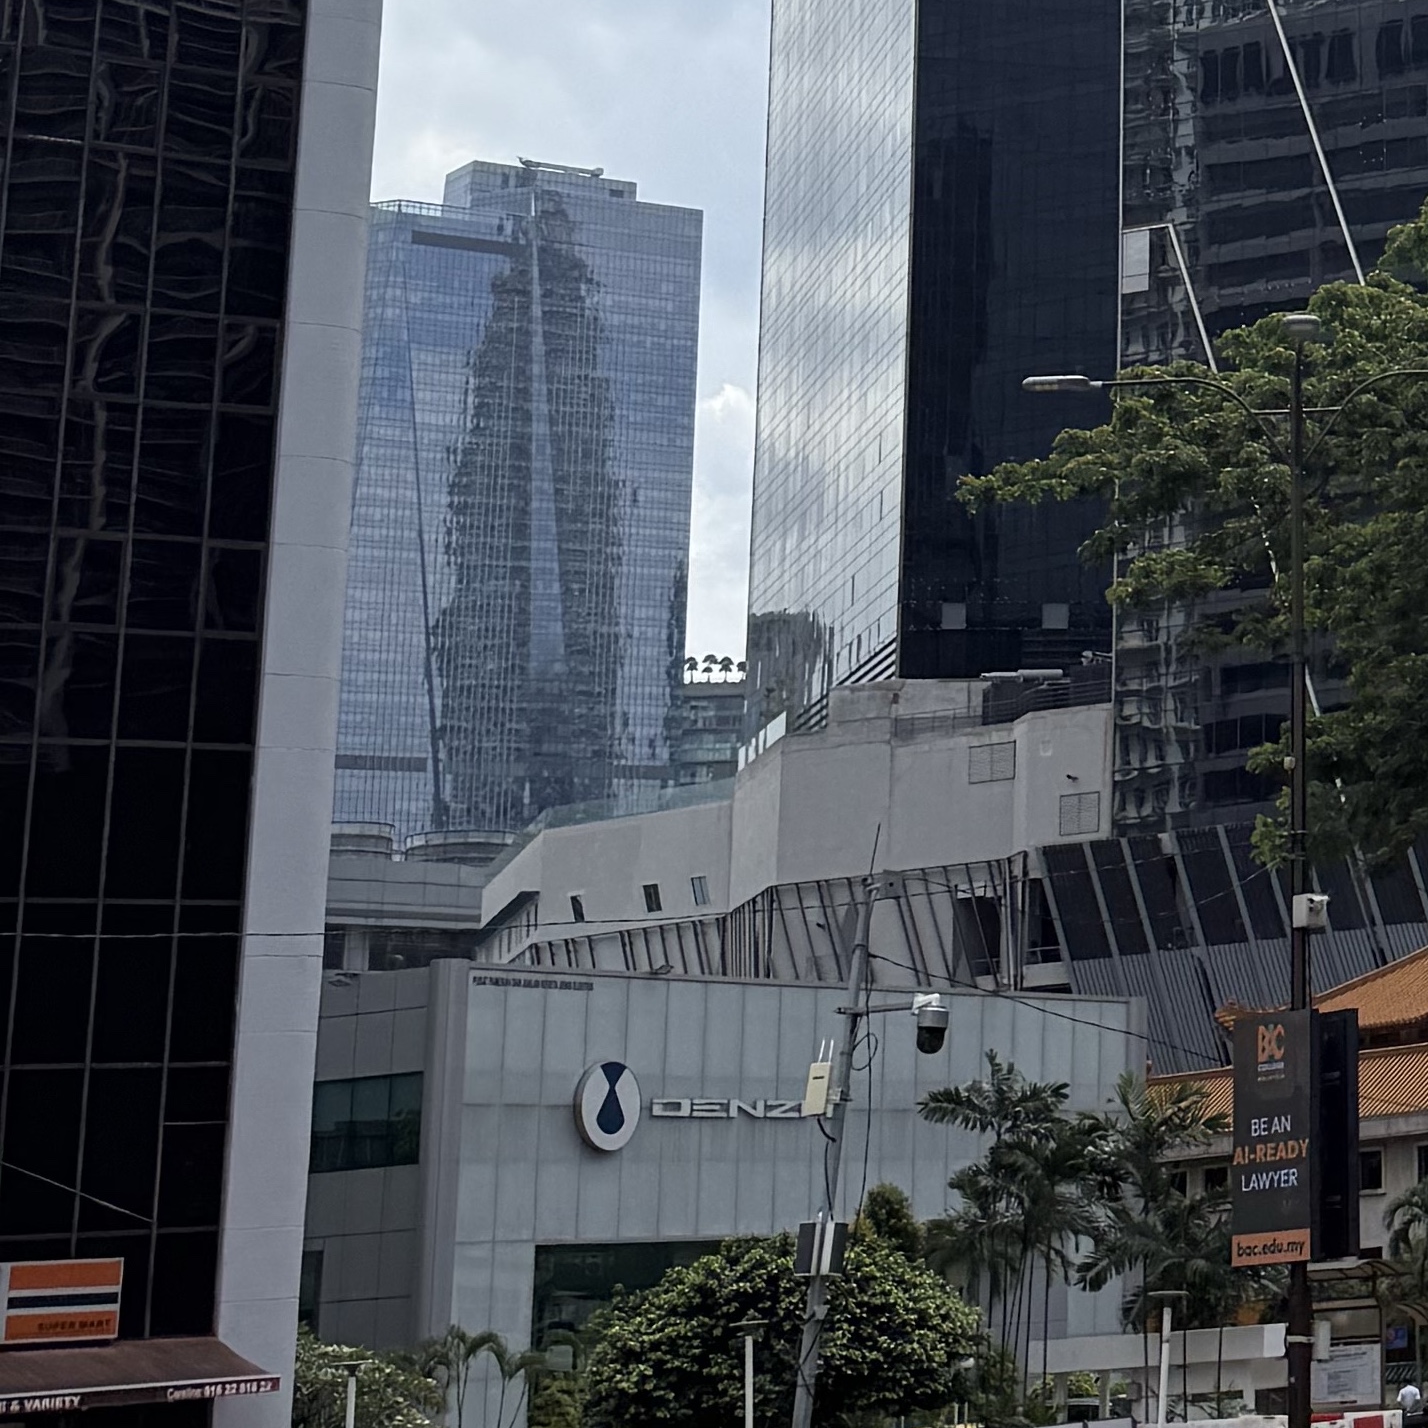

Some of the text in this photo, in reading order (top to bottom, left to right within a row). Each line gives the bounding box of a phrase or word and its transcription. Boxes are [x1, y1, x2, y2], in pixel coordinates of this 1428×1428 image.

[1251, 1115, 1291, 1137] BE AN
[1233, 1138, 1309, 1166] AI-READY
[1241, 1168, 1298, 1192] LAWYER
[1236, 1237, 1305, 1259] bac.edu.my
